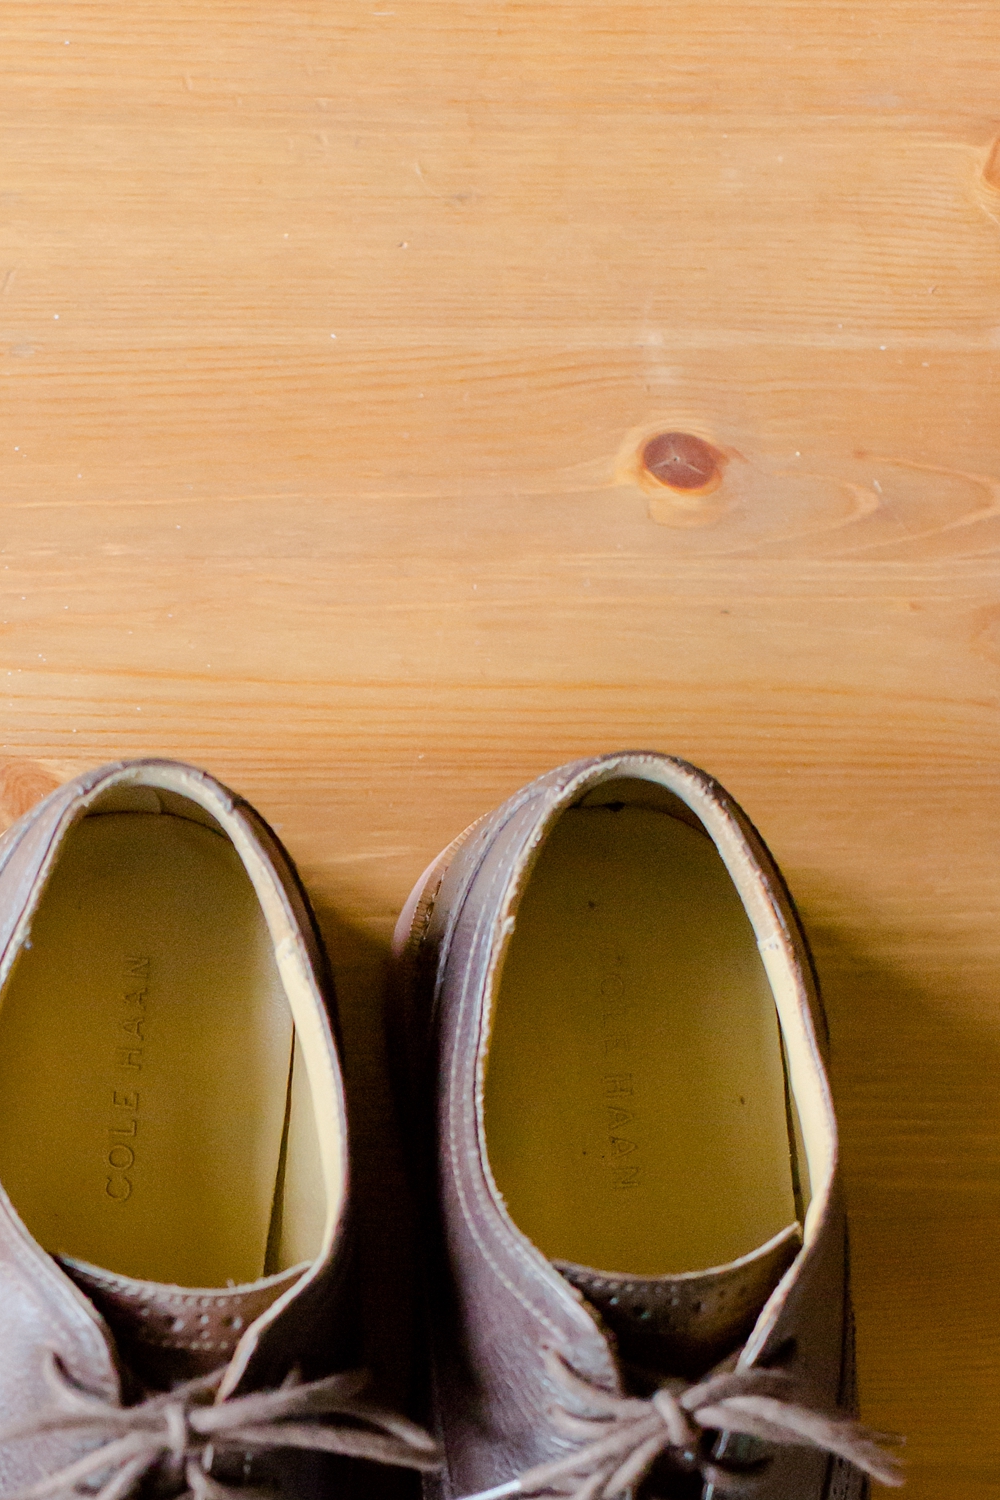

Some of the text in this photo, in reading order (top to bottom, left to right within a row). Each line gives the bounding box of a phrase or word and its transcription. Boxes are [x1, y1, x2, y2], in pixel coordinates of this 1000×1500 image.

[104, 953, 150, 1203] COLE HAAN
[600, 1072, 642, 1190] HAAN
